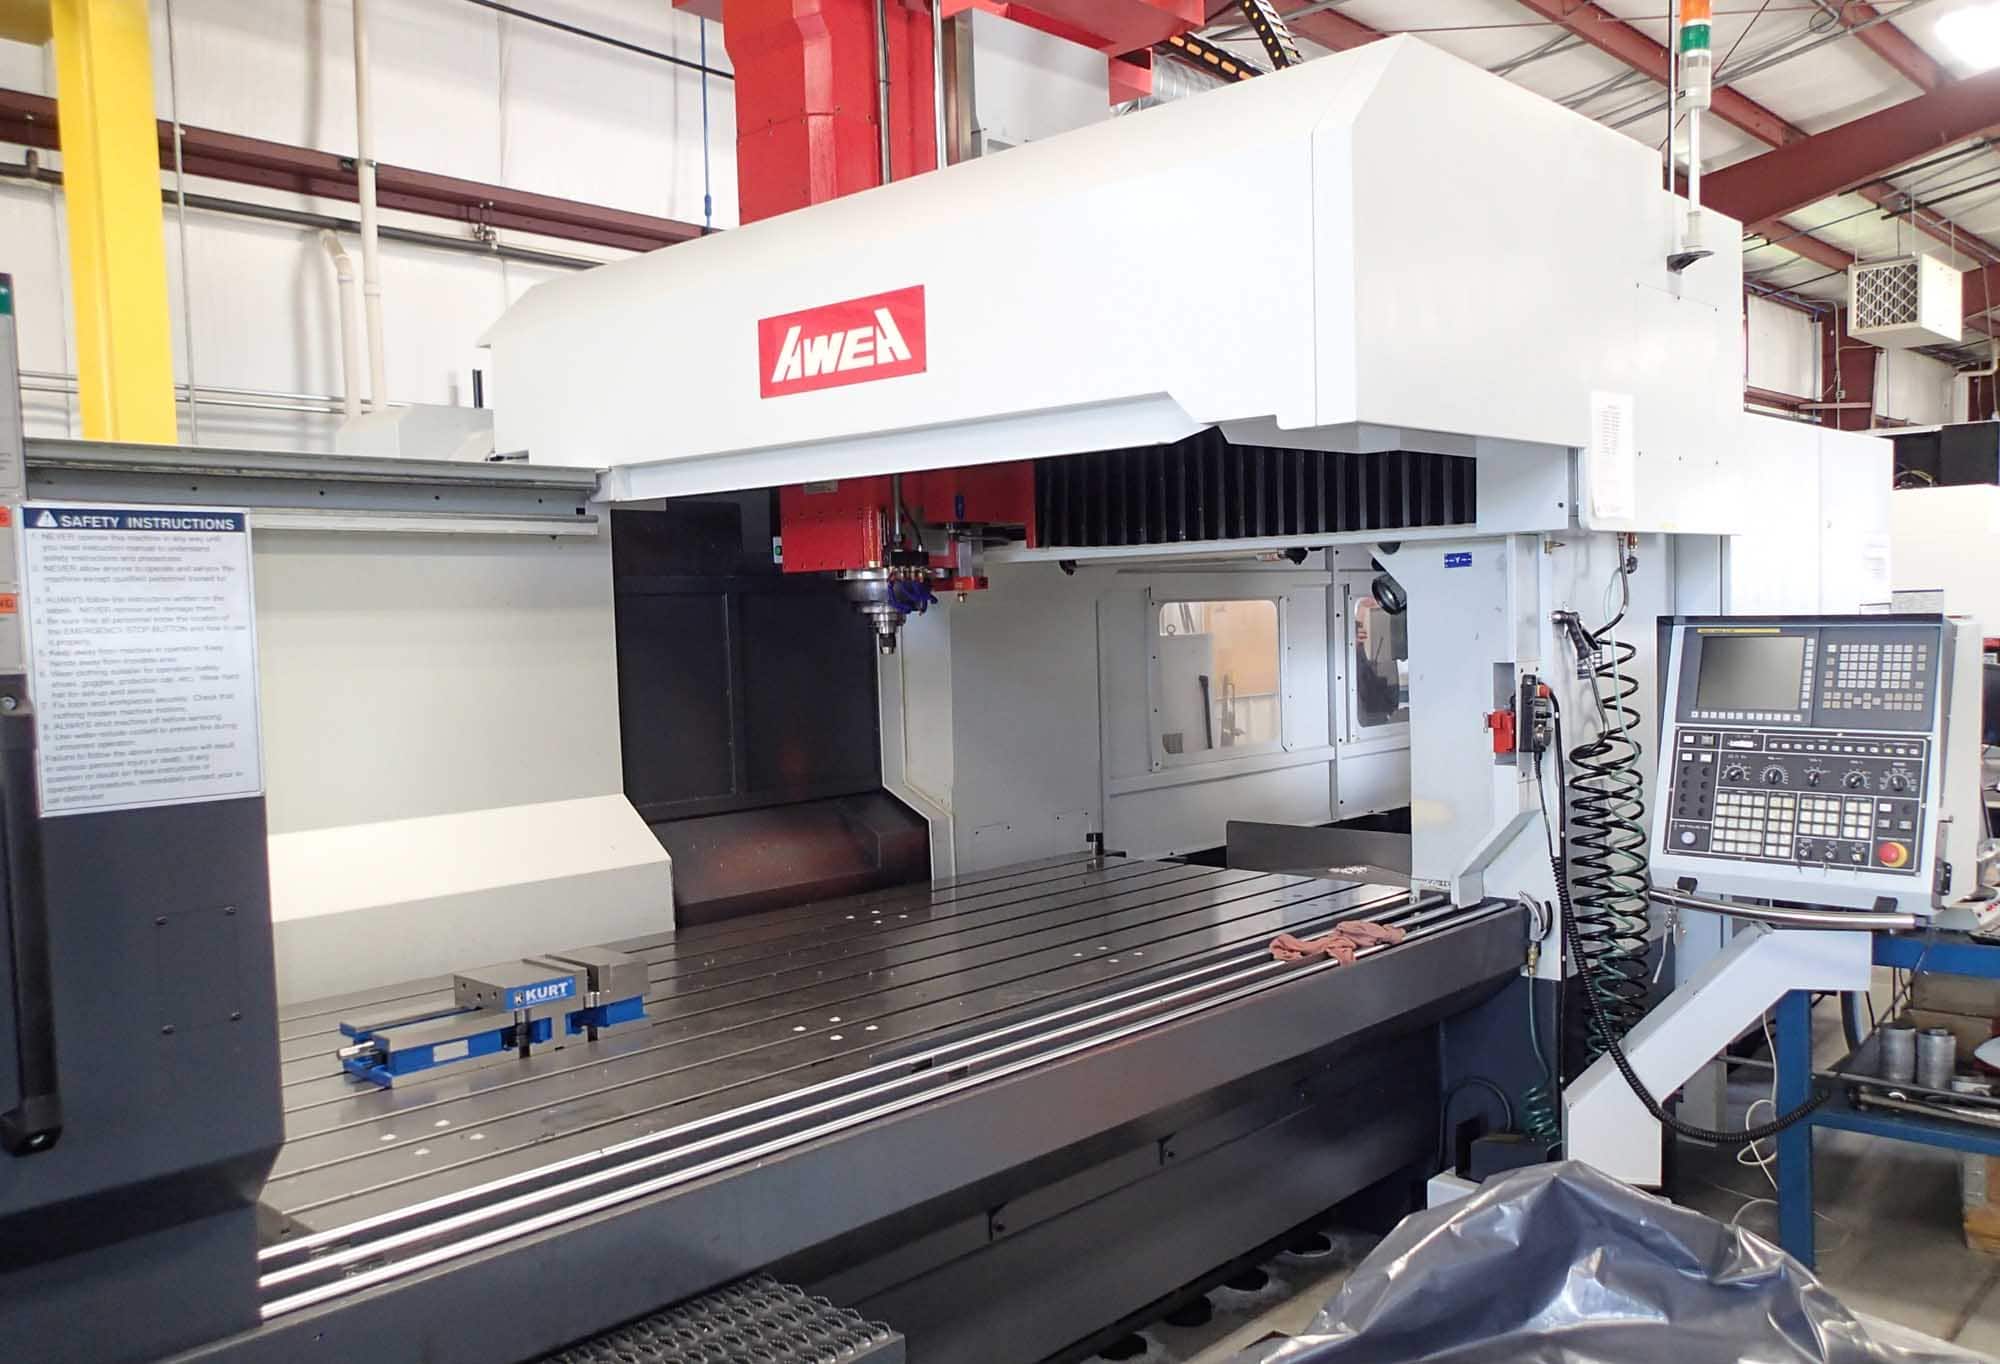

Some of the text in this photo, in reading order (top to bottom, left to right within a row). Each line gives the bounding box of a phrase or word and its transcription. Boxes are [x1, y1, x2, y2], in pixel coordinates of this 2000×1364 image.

[771, 307, 912, 384] AWEA
[60, 515, 235, 531] SAFETY INSTRUCTIONS
[525, 982, 568, 1002] KURT
